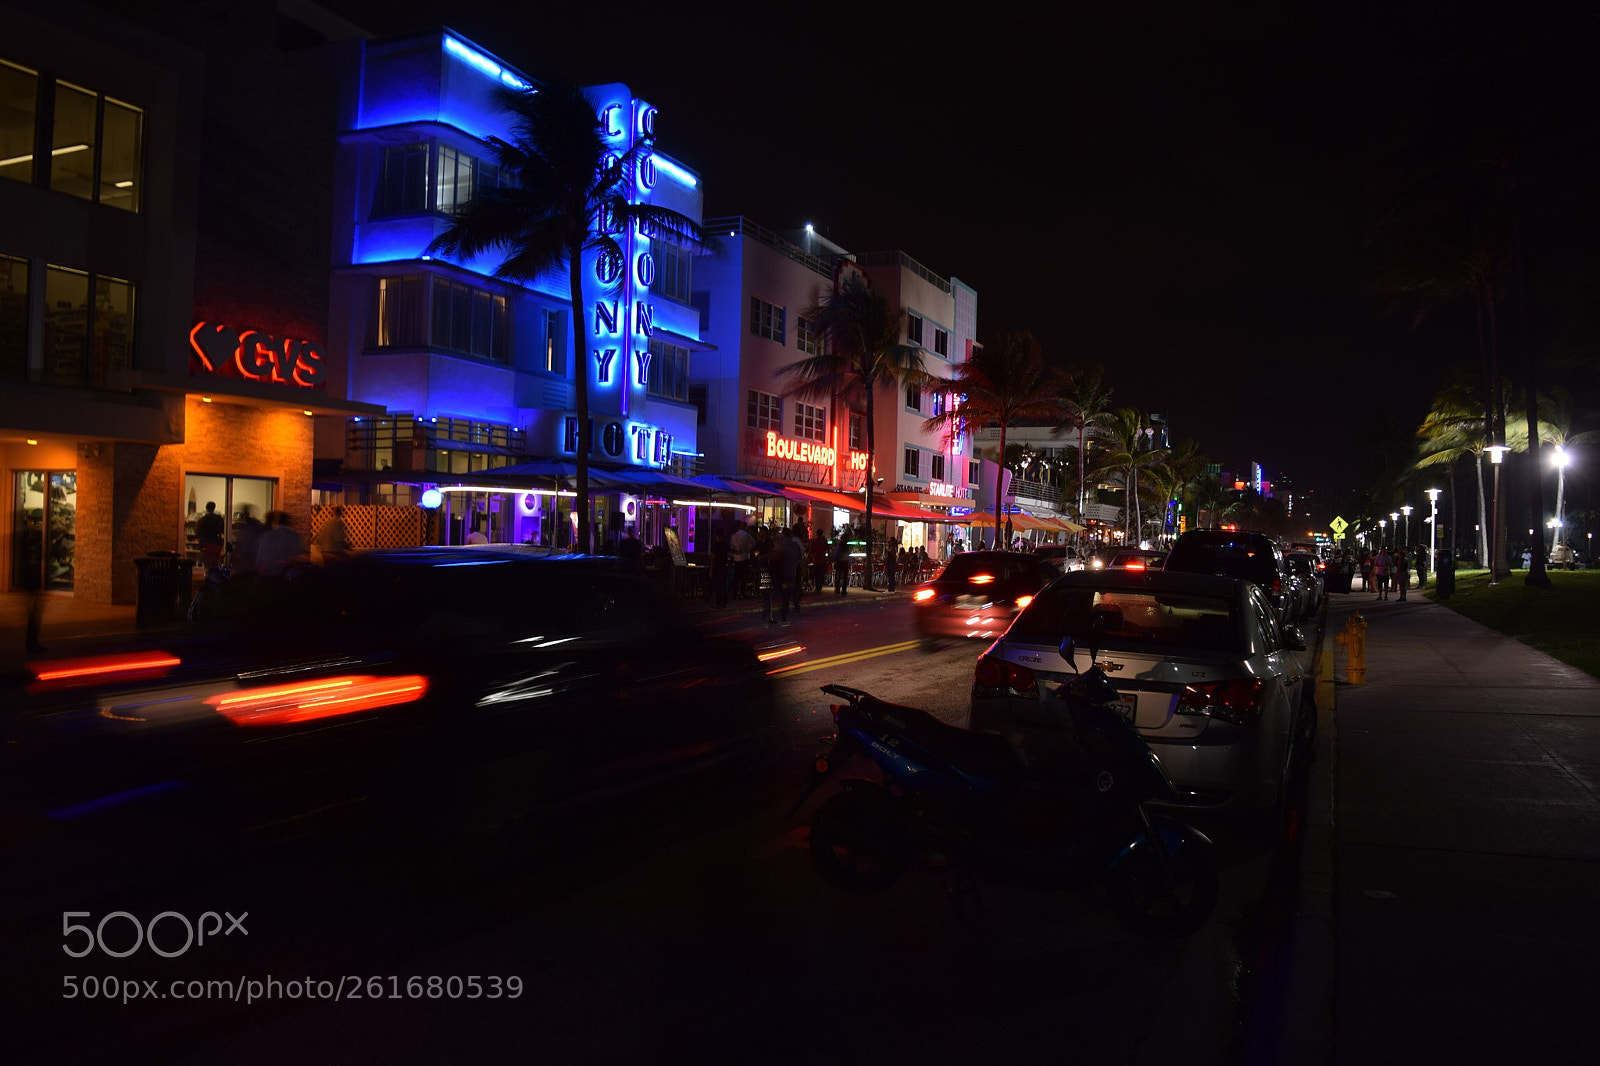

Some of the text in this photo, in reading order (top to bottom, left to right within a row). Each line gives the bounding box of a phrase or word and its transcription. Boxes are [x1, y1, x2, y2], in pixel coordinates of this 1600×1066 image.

[634, 106, 658, 386] COLONY
[235, 330, 327, 387] CVS
[766, 430, 835, 467] BOULEVARD
[929, 481, 954, 498] STARLITE
